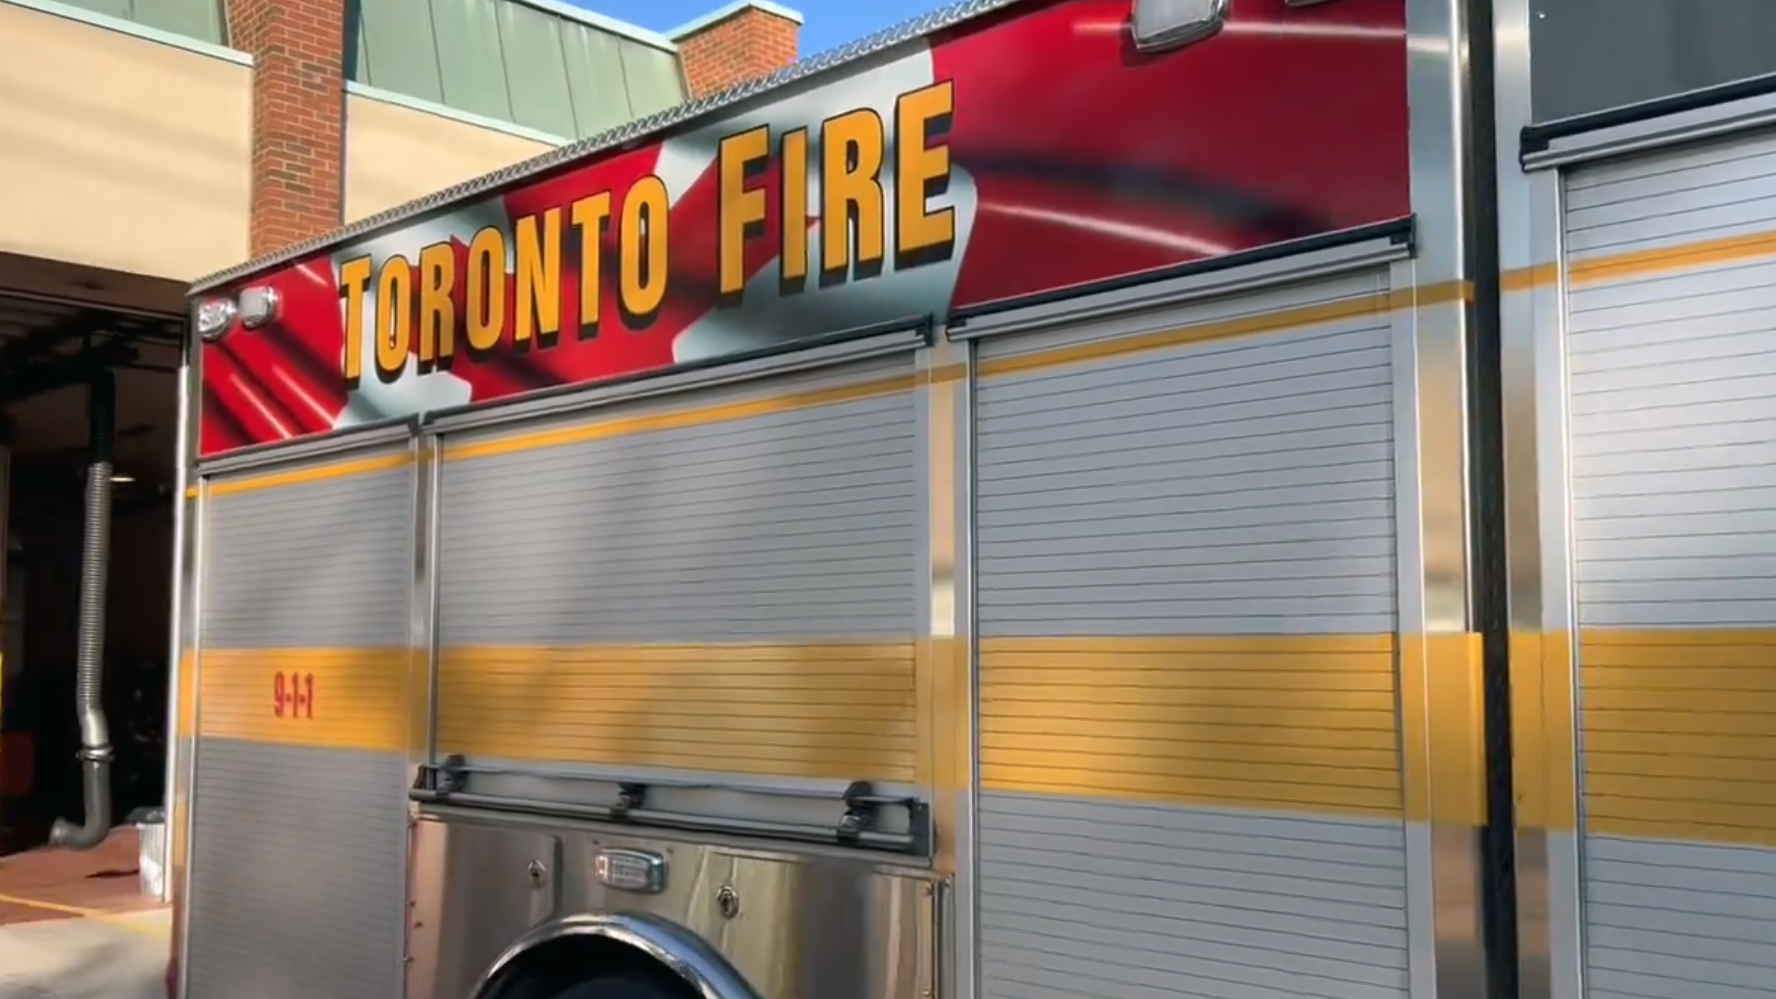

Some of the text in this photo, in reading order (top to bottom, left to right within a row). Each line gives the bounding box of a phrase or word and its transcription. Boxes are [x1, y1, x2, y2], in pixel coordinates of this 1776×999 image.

[339, 79, 955, 385] TORONTO FIRE
[273, 671, 315, 719] 9-1-1
